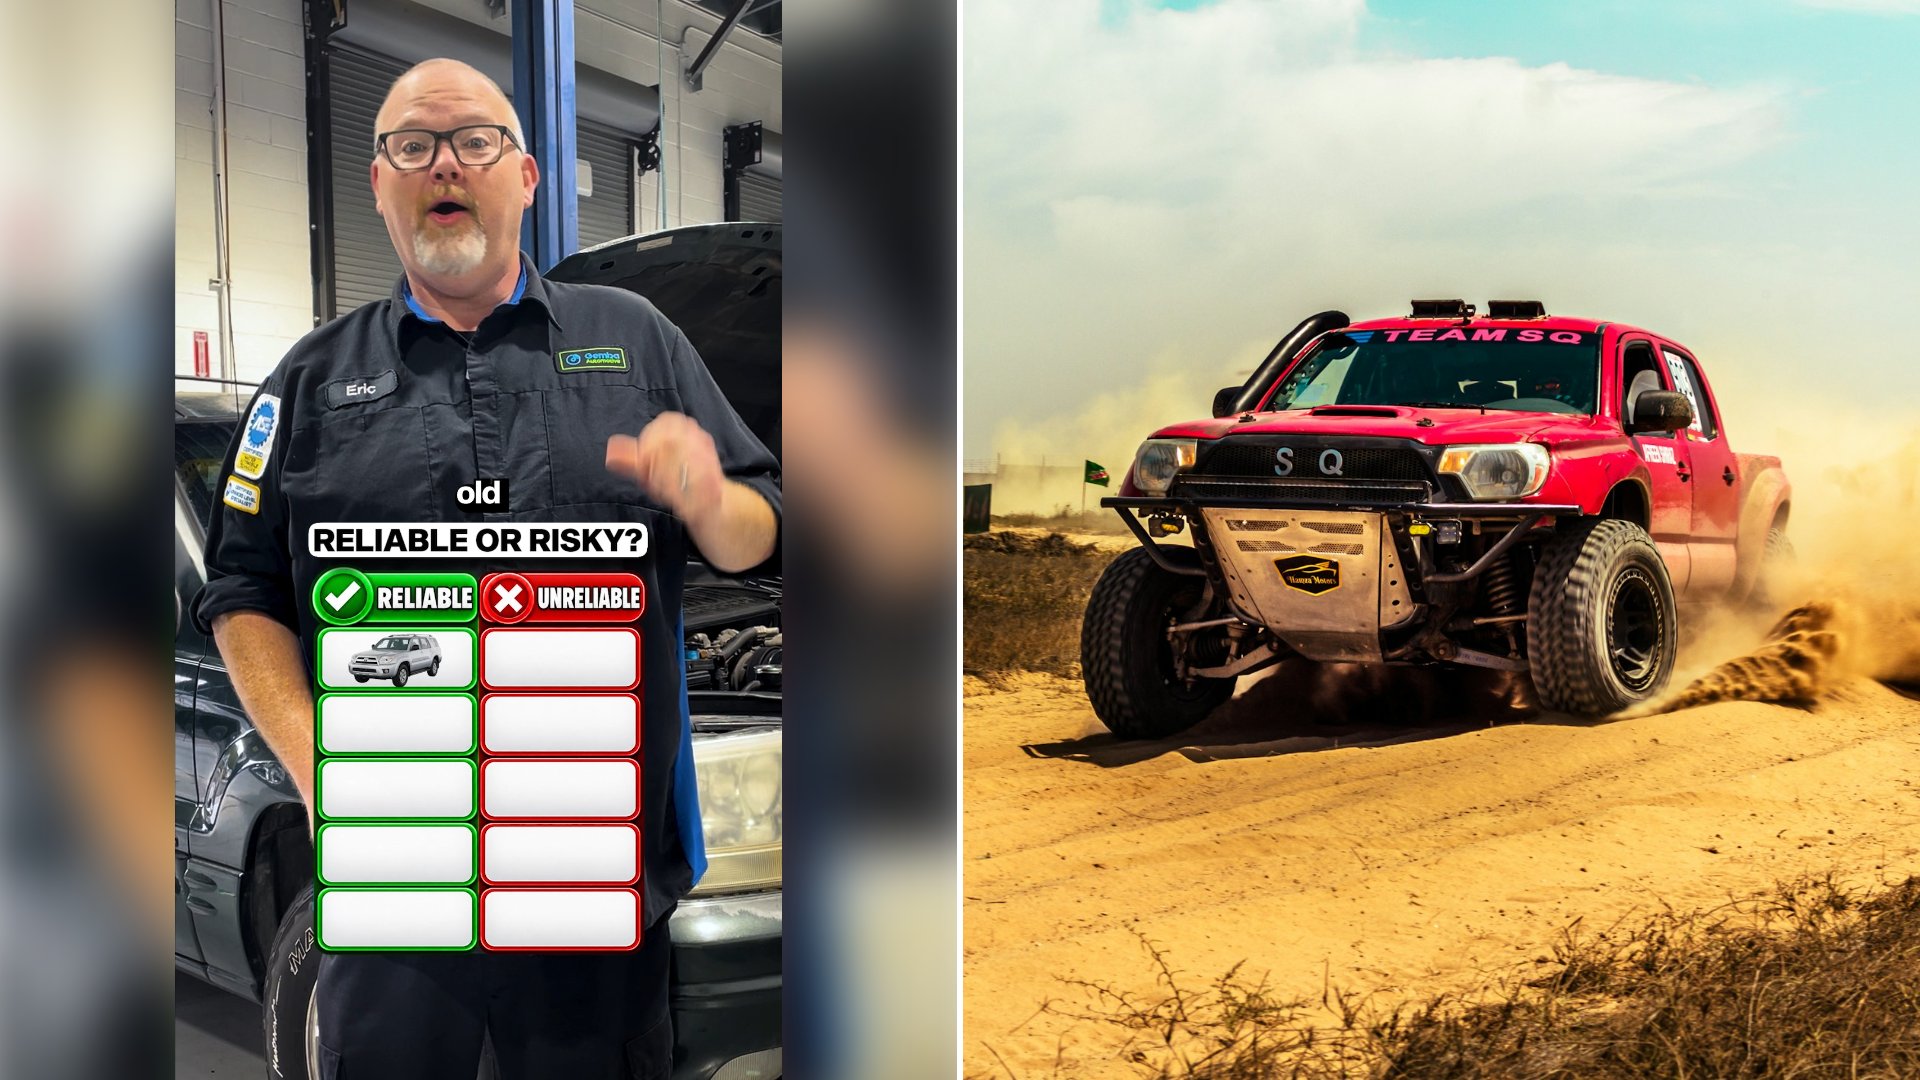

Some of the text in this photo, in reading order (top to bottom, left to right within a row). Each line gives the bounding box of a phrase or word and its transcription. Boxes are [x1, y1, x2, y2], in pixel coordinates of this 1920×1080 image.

[1384, 329, 1582, 344] TEAM SQ
[345, 383, 377, 396] Eric
[1311, 575, 1337, 585] Motors
